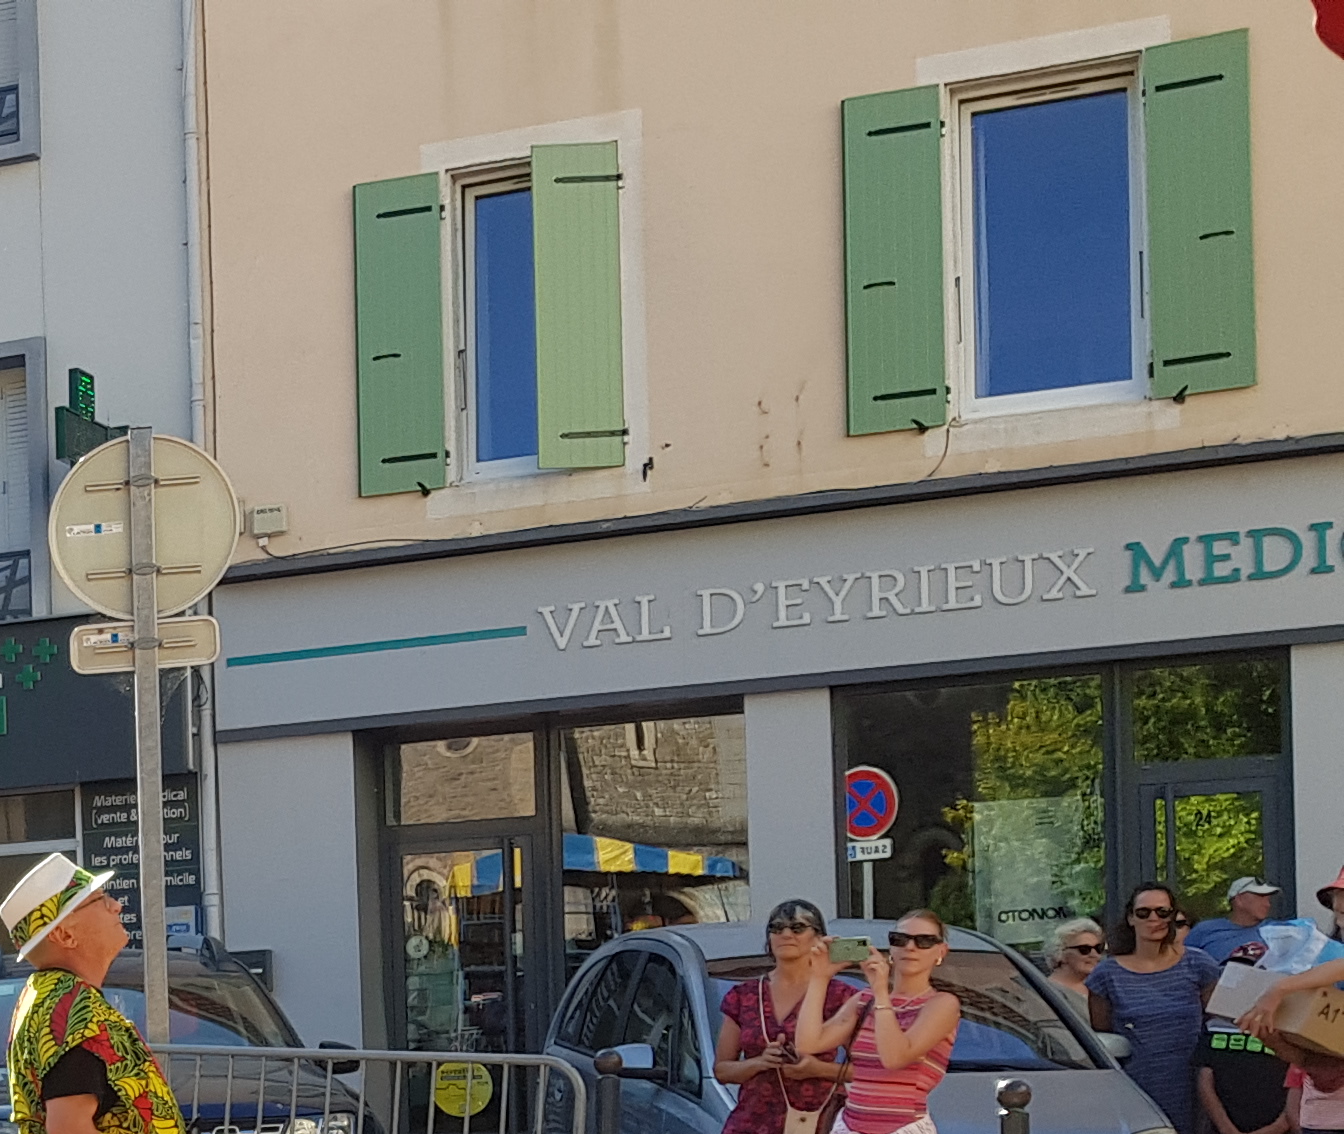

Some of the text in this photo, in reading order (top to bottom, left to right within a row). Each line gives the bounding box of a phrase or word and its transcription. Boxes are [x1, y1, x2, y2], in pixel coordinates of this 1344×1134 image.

[537, 521, 1344, 651] VAL D'EYRIEUX MEDI
[92, 793, 138, 807] Materie
[1195, 808, 1212, 828] 24
[91, 853, 107, 867] les
